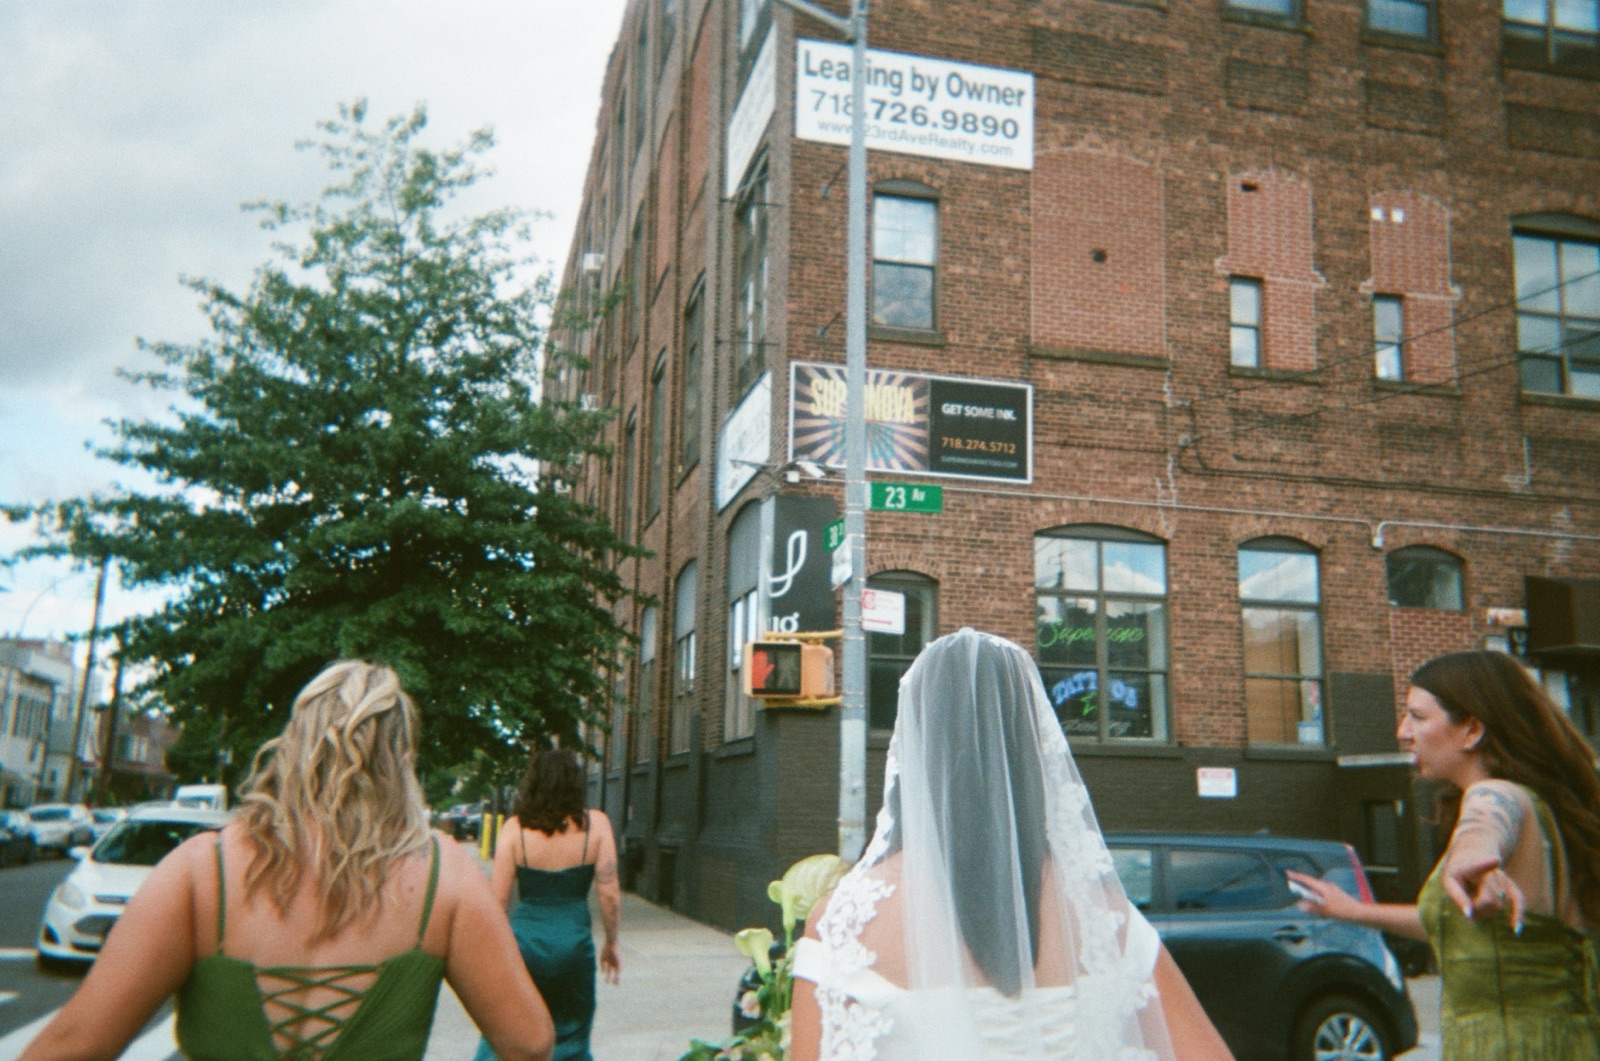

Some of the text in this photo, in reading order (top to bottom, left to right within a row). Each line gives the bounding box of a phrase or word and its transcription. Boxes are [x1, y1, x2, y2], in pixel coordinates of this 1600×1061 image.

[804, 50, 1025, 108] Leaing by Owner
[810, 378, 916, 424] SUPNOVA
[941, 403, 963, 416] GET
[964, 405, 995, 419] SOME
[885, 486, 906, 509] 23
